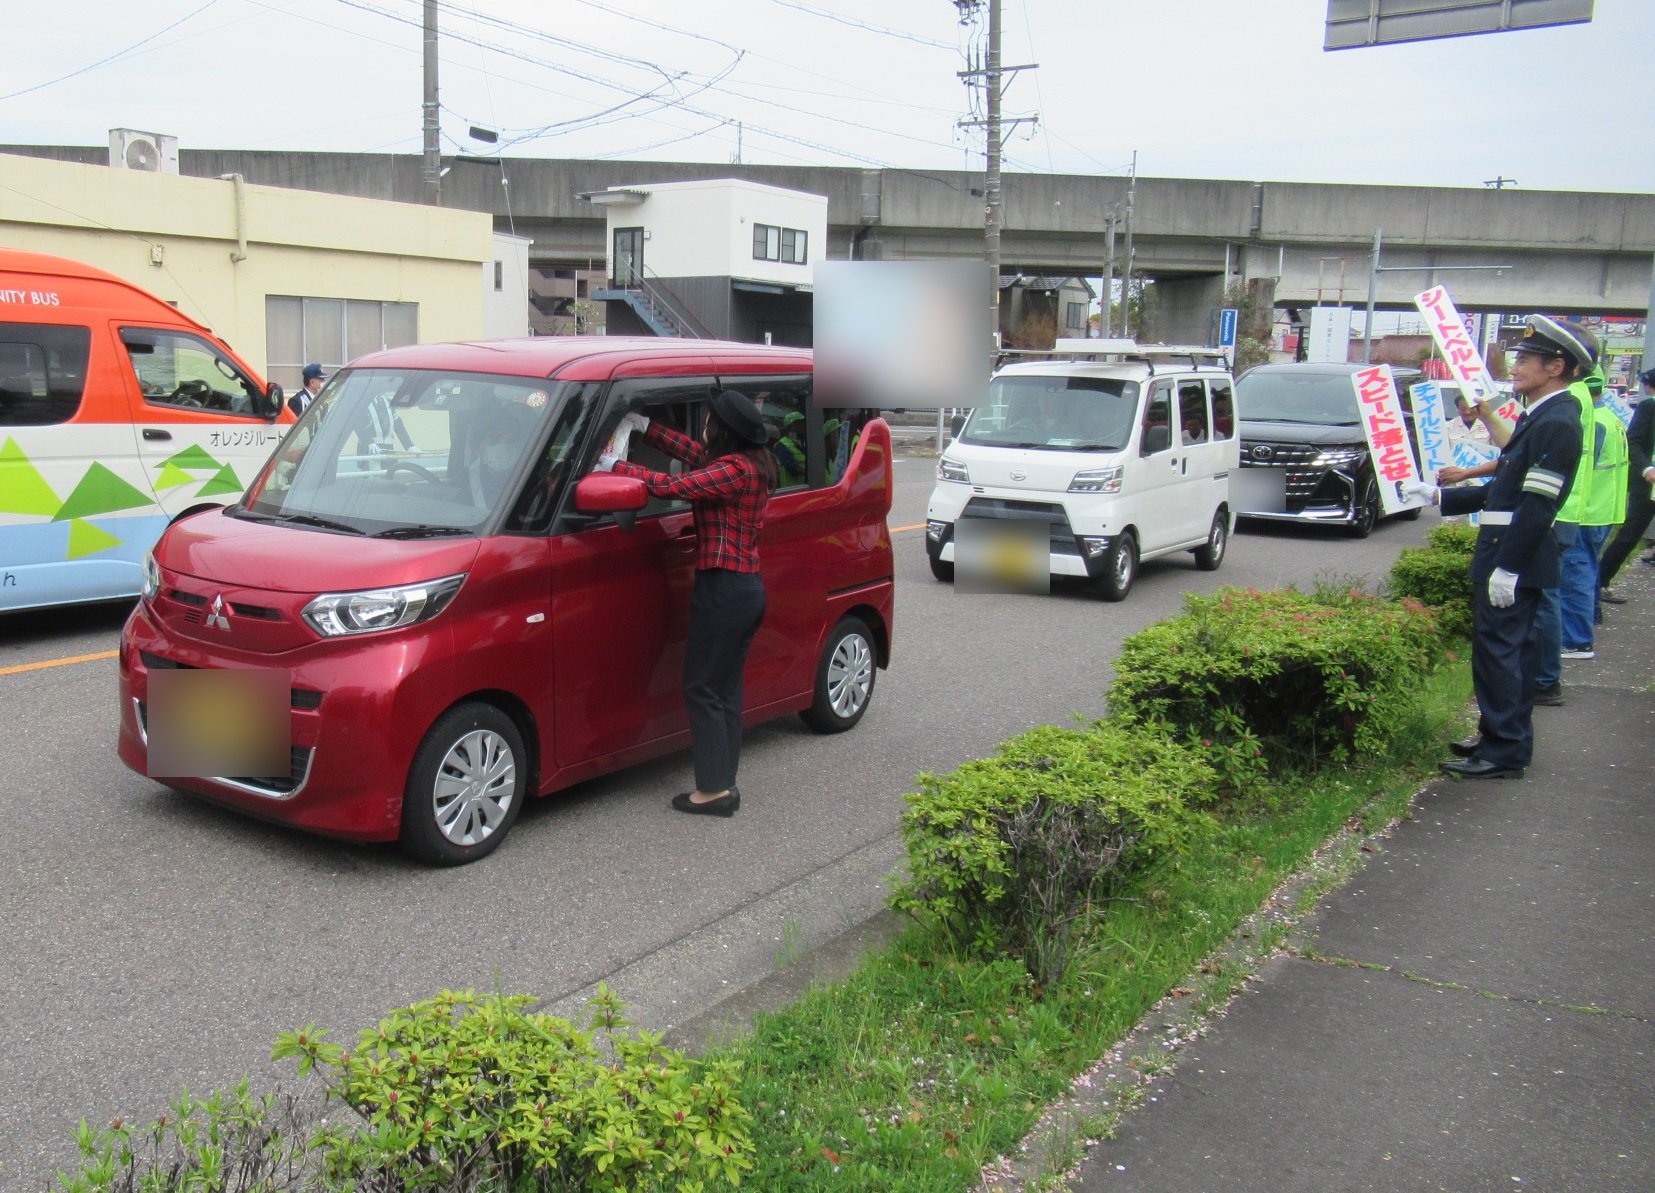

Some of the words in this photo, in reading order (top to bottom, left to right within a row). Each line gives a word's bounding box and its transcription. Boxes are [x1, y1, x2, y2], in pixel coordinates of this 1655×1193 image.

[30, 291, 60, 306] BUS
[1421, 289, 1481, 381] シートベルト
[210, 430, 284, 447] オレンジルート
[1357, 367, 1413, 481] スピード落とせ
[1413, 383, 1446, 471] チャイルドシート
